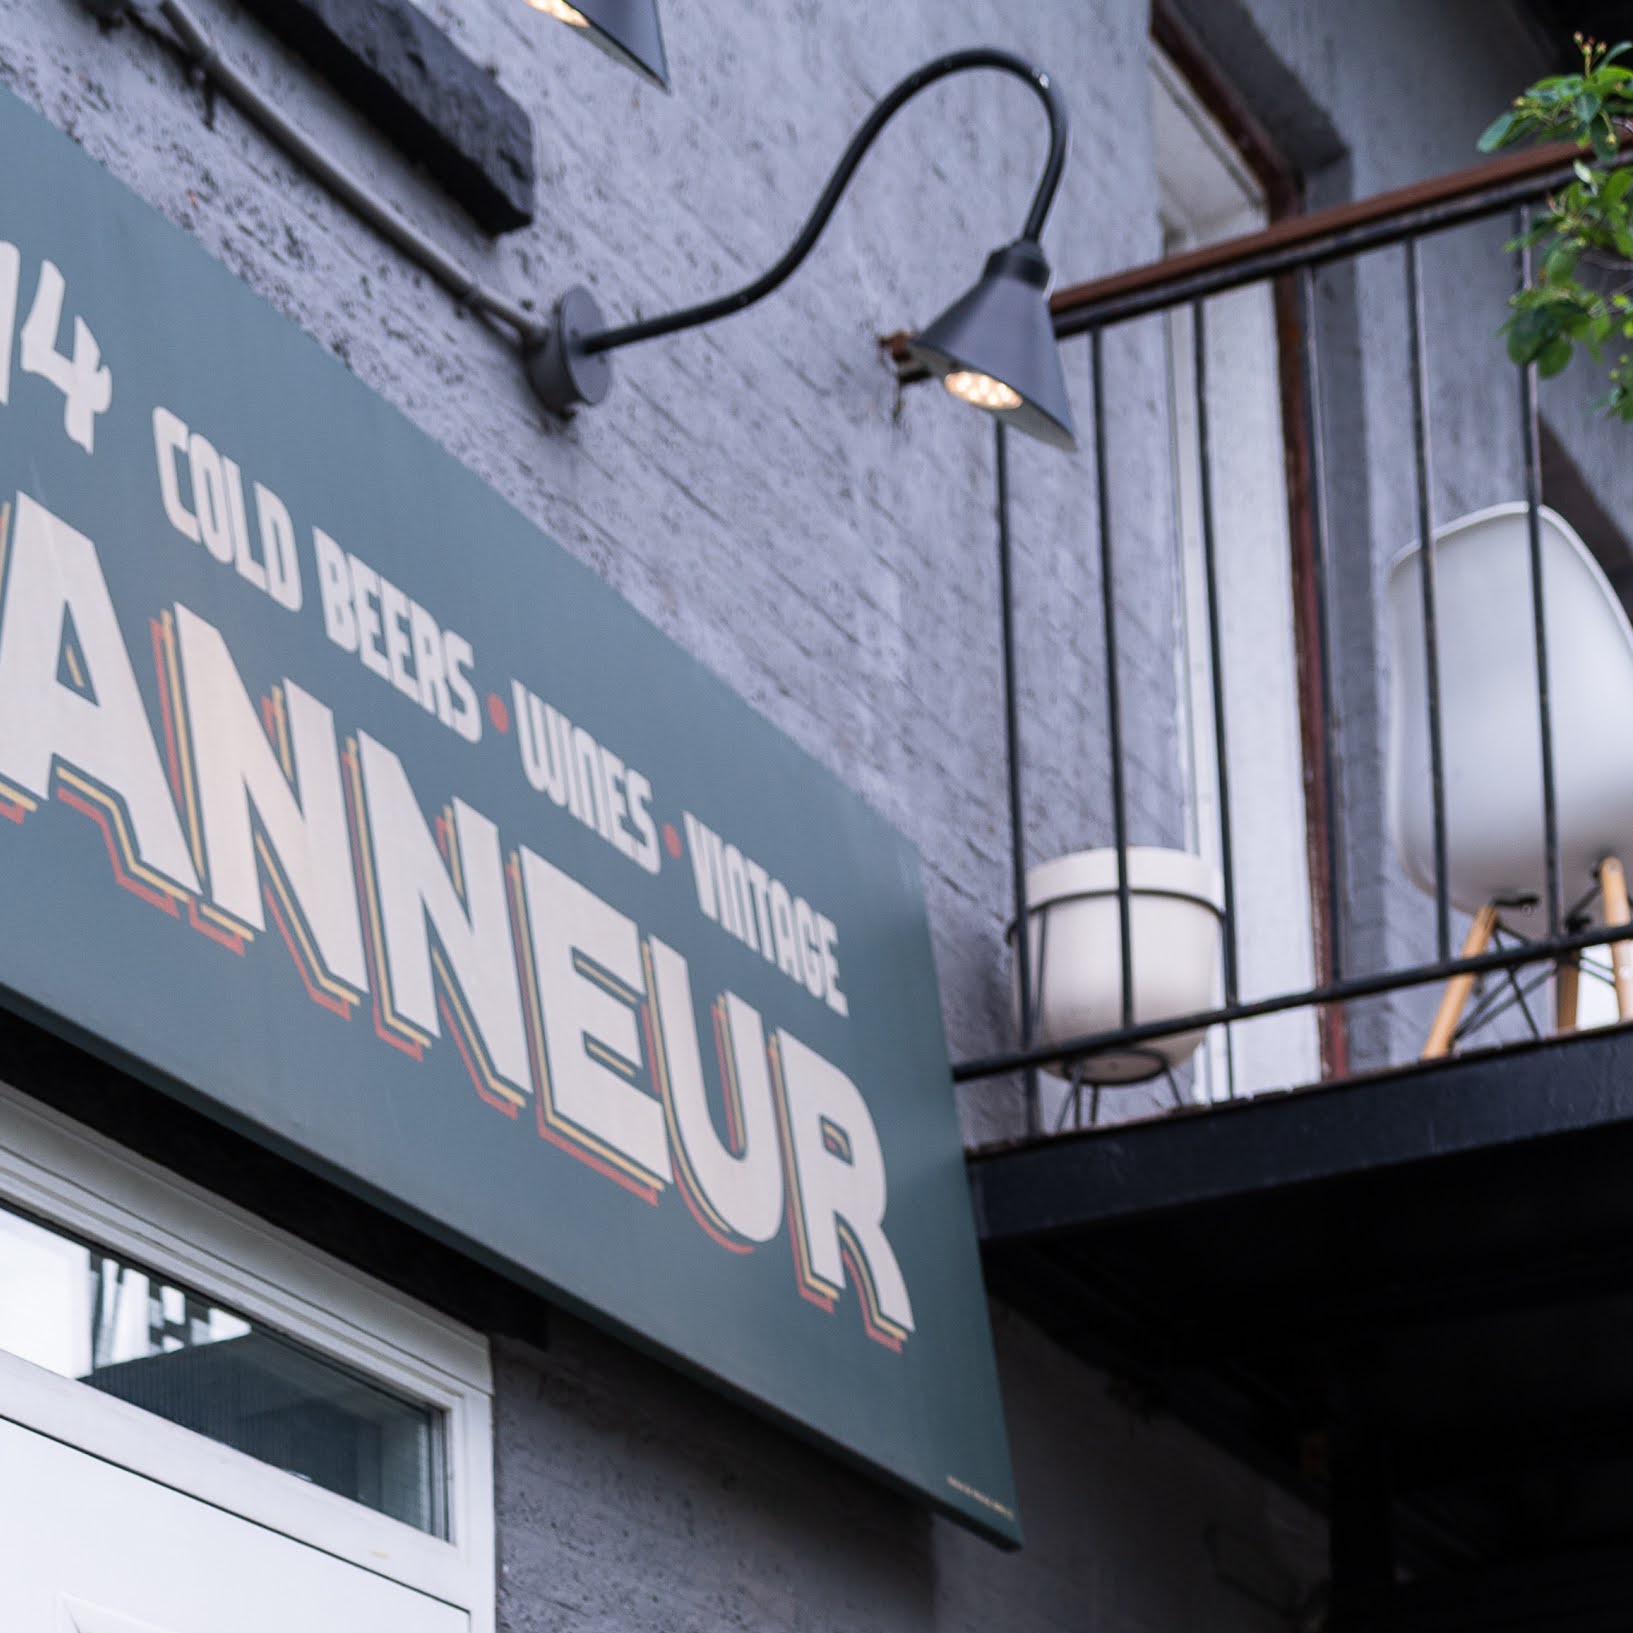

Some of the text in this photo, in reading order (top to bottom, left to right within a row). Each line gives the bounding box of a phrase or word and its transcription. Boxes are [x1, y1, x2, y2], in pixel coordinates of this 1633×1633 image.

[151, 405, 850, 1019] COLD BEERS WINES VINTAGE
